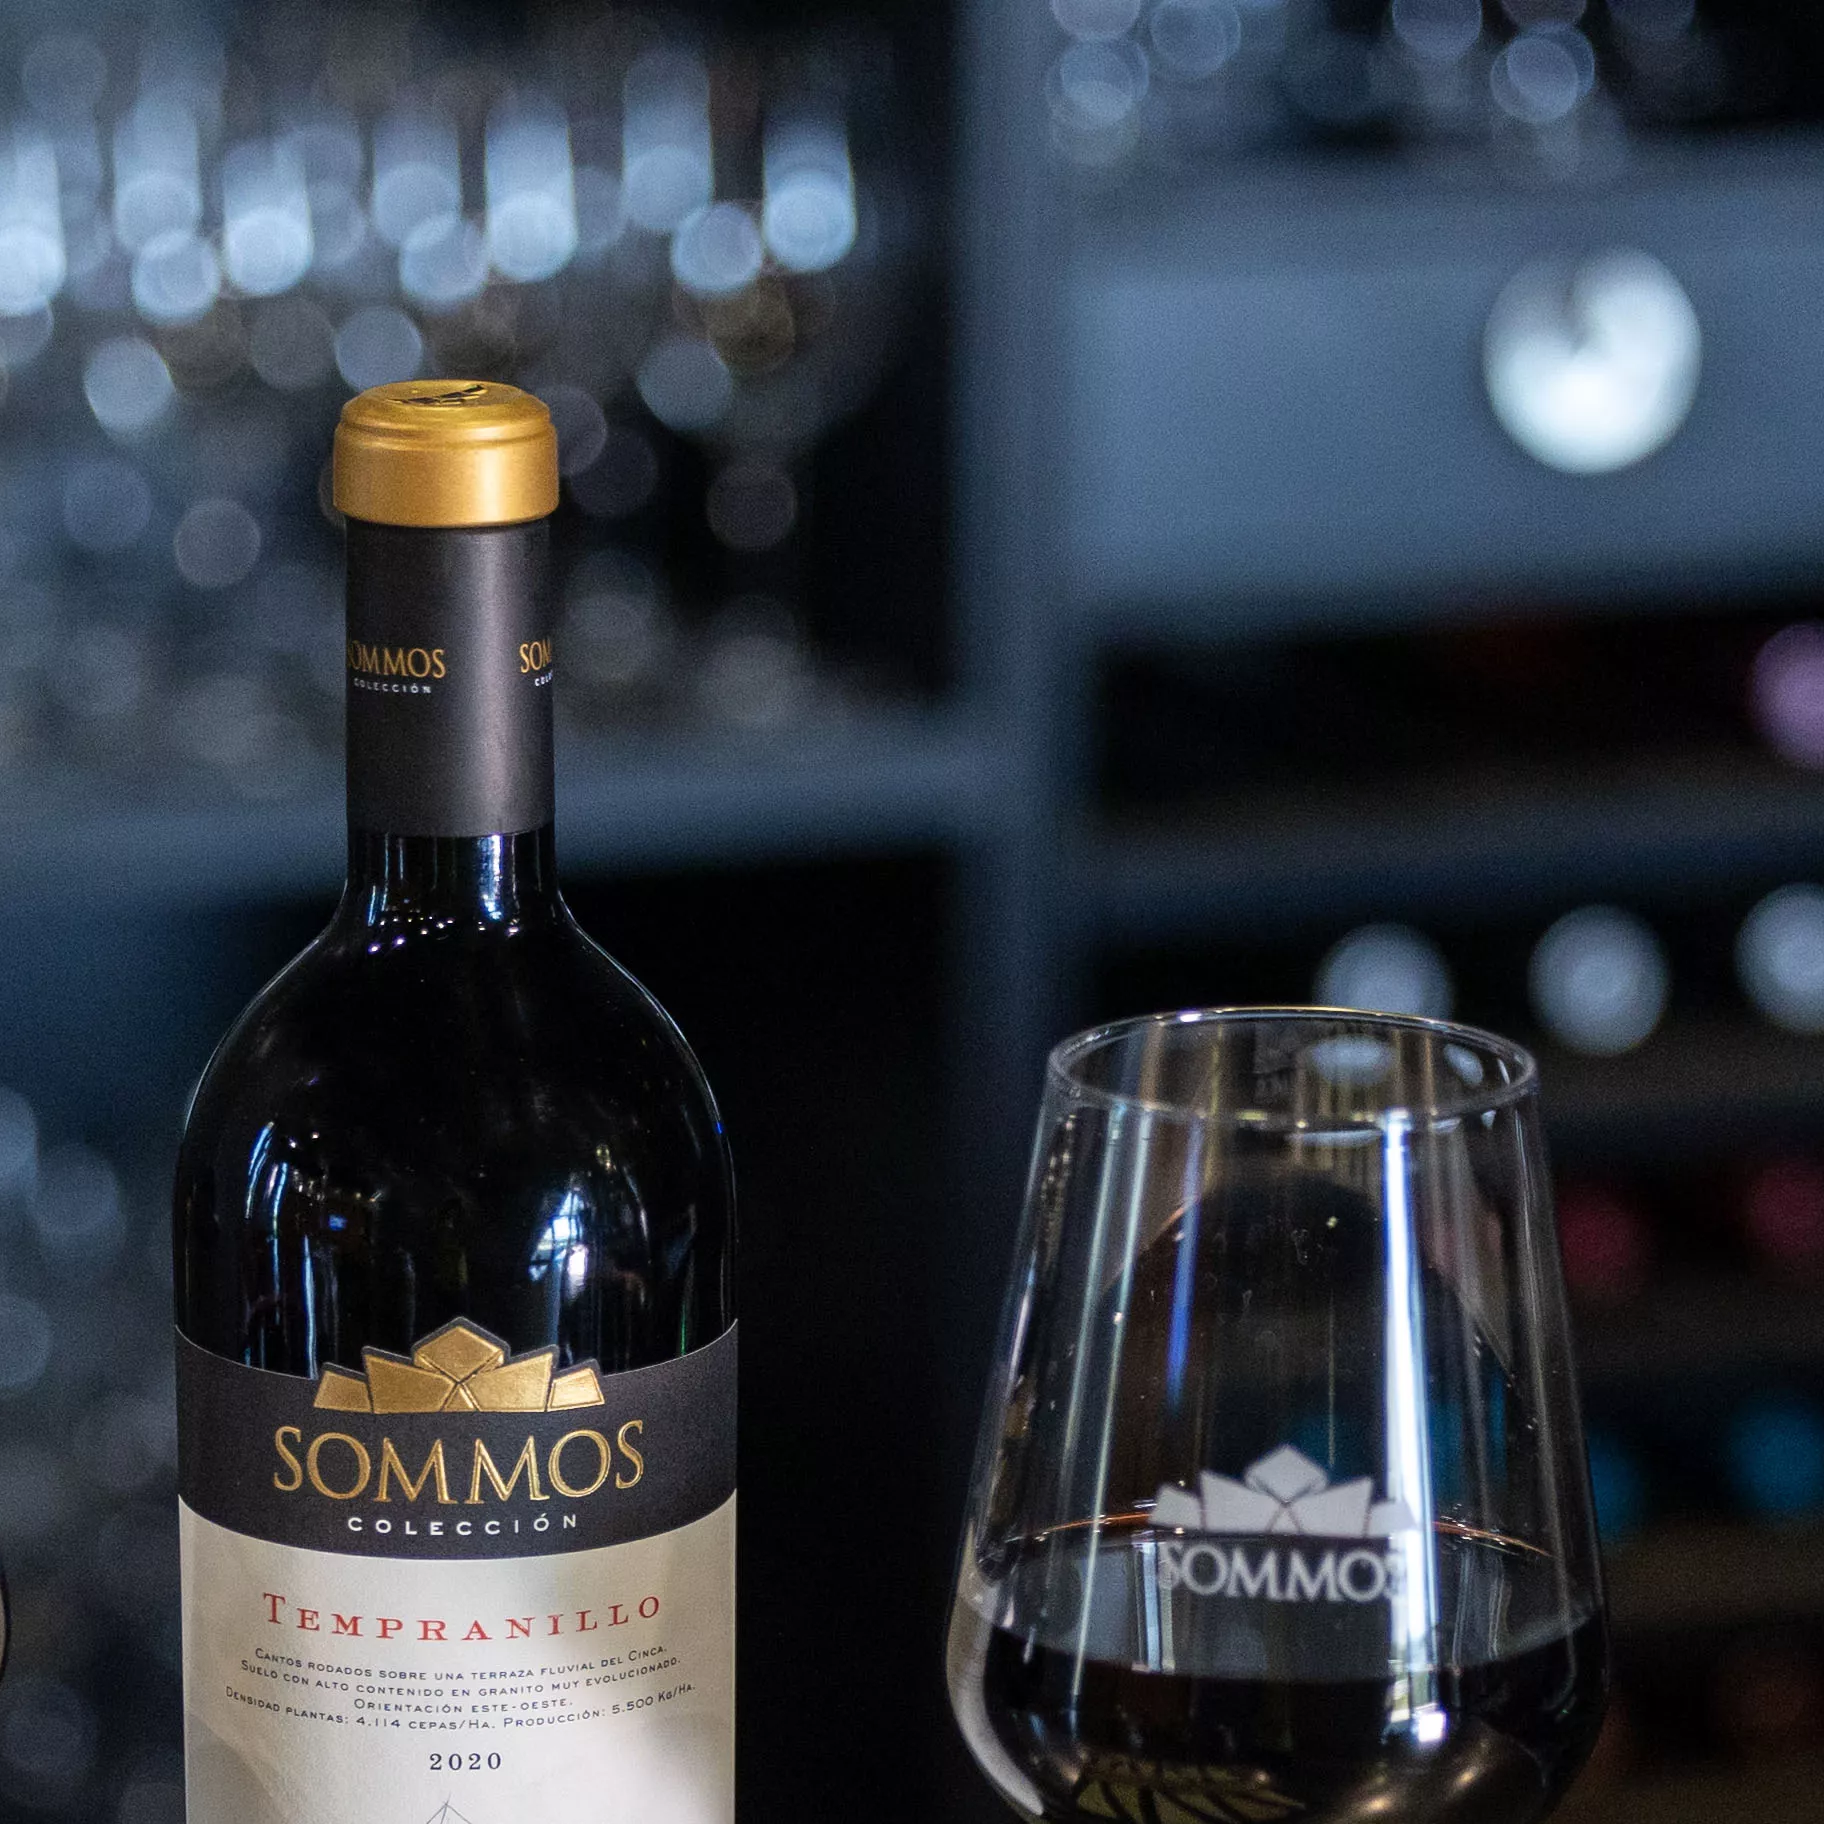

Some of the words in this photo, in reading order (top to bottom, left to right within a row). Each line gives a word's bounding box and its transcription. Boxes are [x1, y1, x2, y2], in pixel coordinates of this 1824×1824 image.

[347, 640, 446, 678] OMMOS
[519, 636, 553, 673] SOM
[273, 1420, 645, 1504] SOMMOS
[347, 1513, 577, 1536] COLECCIÓN
[263, 1593, 660, 1641] TEMPRANILLO
[308, 1662, 372, 1677] RODADOS
[379, 1670, 426, 1680] SOBRE
[435, 1672, 463, 1681] UNA
[472, 1670, 534, 1680] TERRAZA
[540, 1662, 595, 1675] FLUVIAL
[601, 1657, 623, 1668] DEL
[283, 1673, 309, 1685] CON
[315, 1681, 349, 1691] ALTO
[356, 1684, 444, 1697] CONTENIDO
[451, 1688, 470, 1697] EN
[479, 1685, 543, 1697] GRANITO
[551, 1680, 580, 1692] MUY
[286, 1707, 348, 1724] PLANTAS:
[612, 1696, 654, 1714] 5.500
[429, 1752, 501, 1771] 2020
